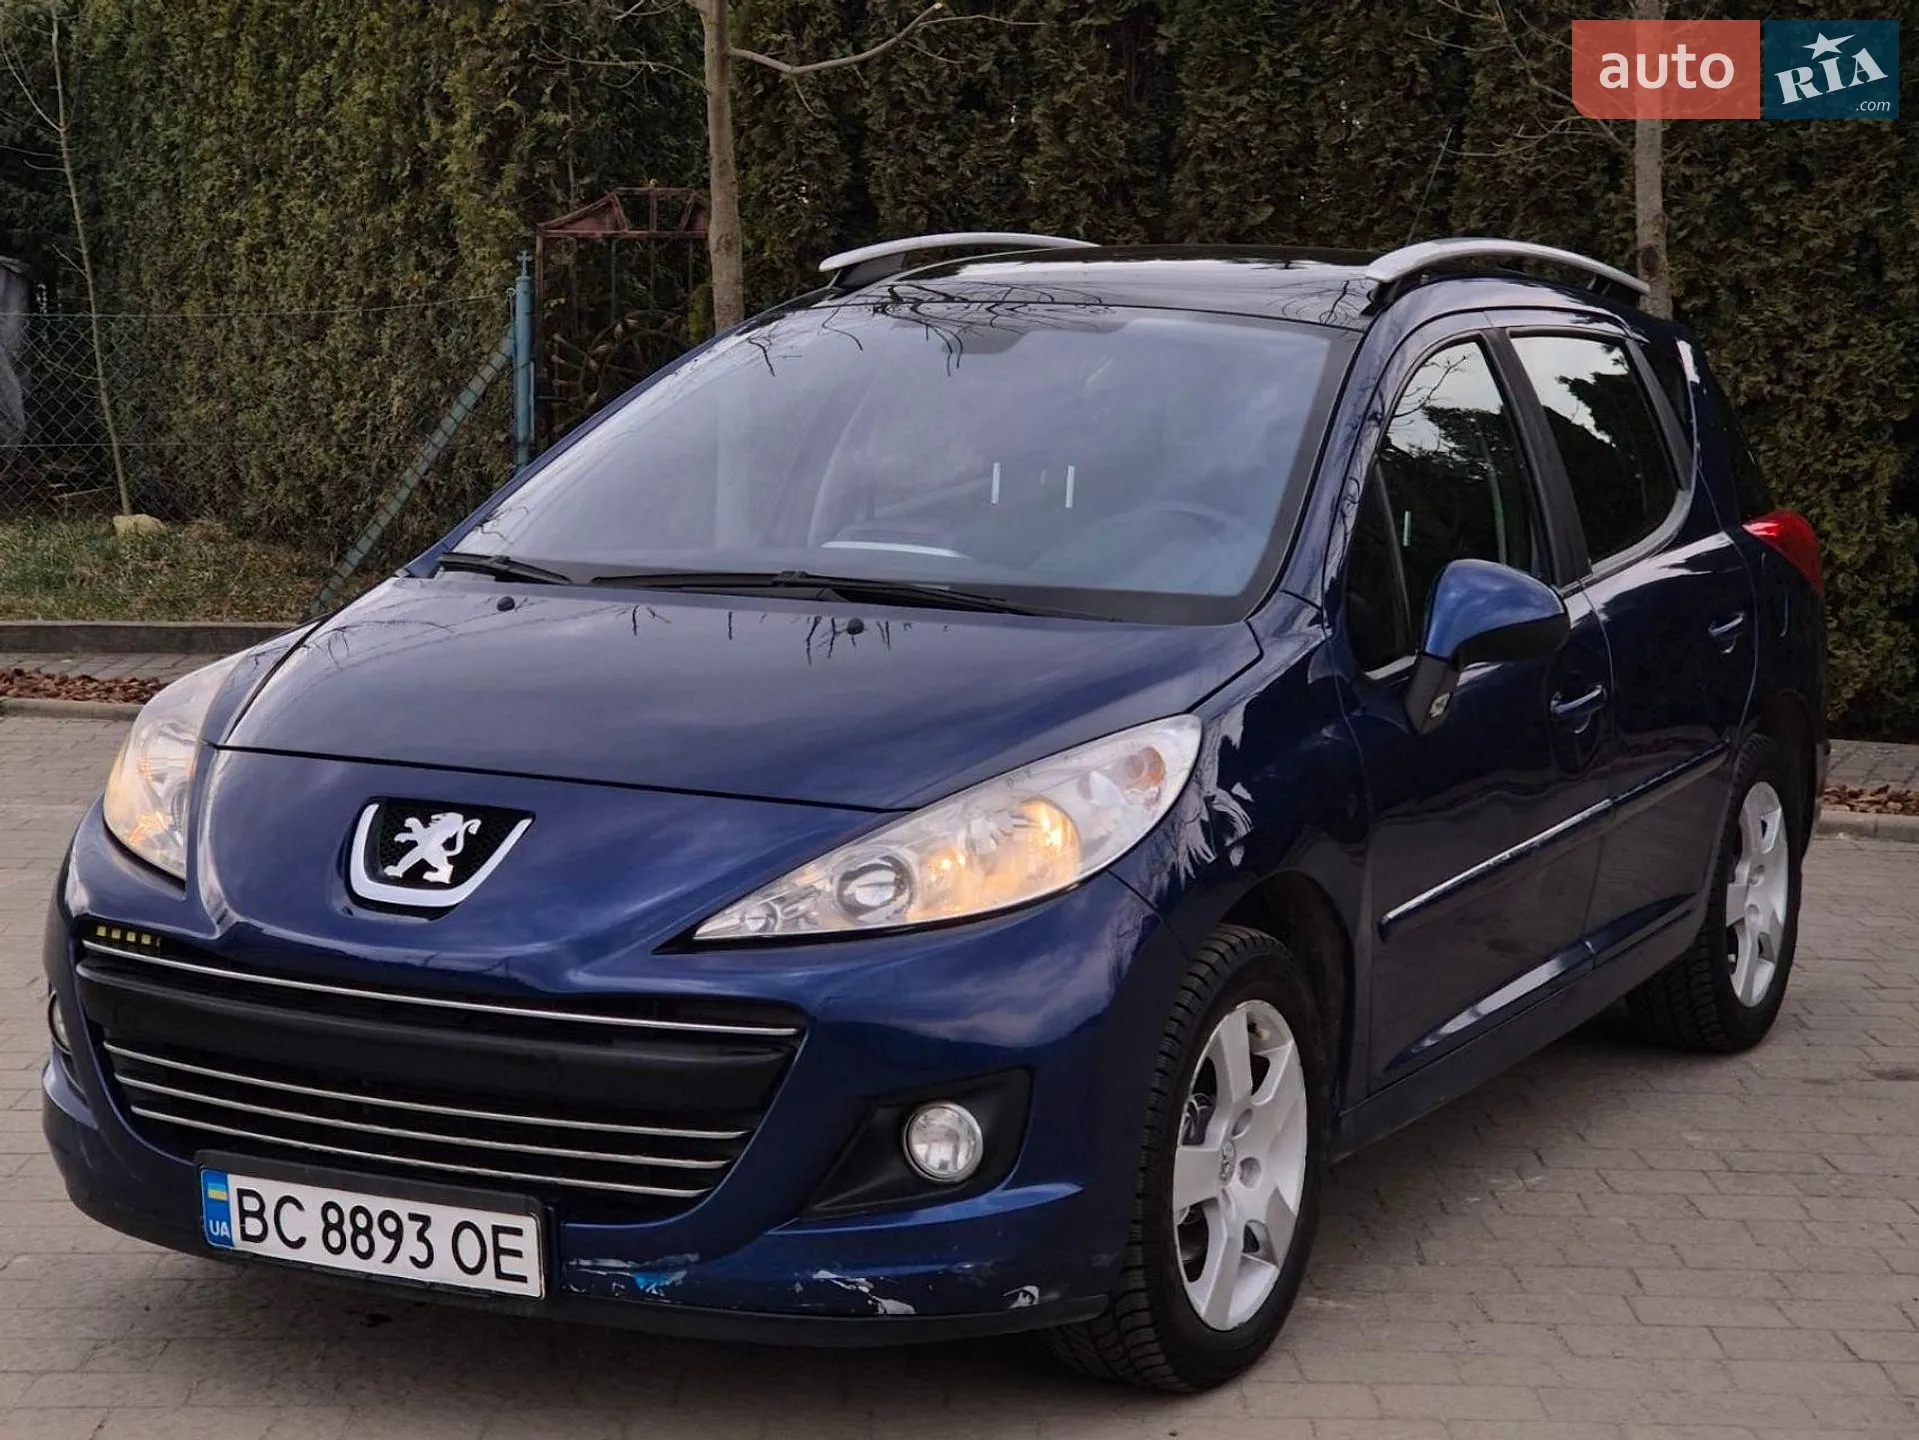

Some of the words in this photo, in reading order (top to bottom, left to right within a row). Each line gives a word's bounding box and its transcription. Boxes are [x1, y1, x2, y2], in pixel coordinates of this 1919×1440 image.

[208, 1219, 231, 1239] UA
[236, 1187, 307, 1250] BC
[320, 1200, 435, 1269] 8893
[451, 1220, 528, 1284] OE
